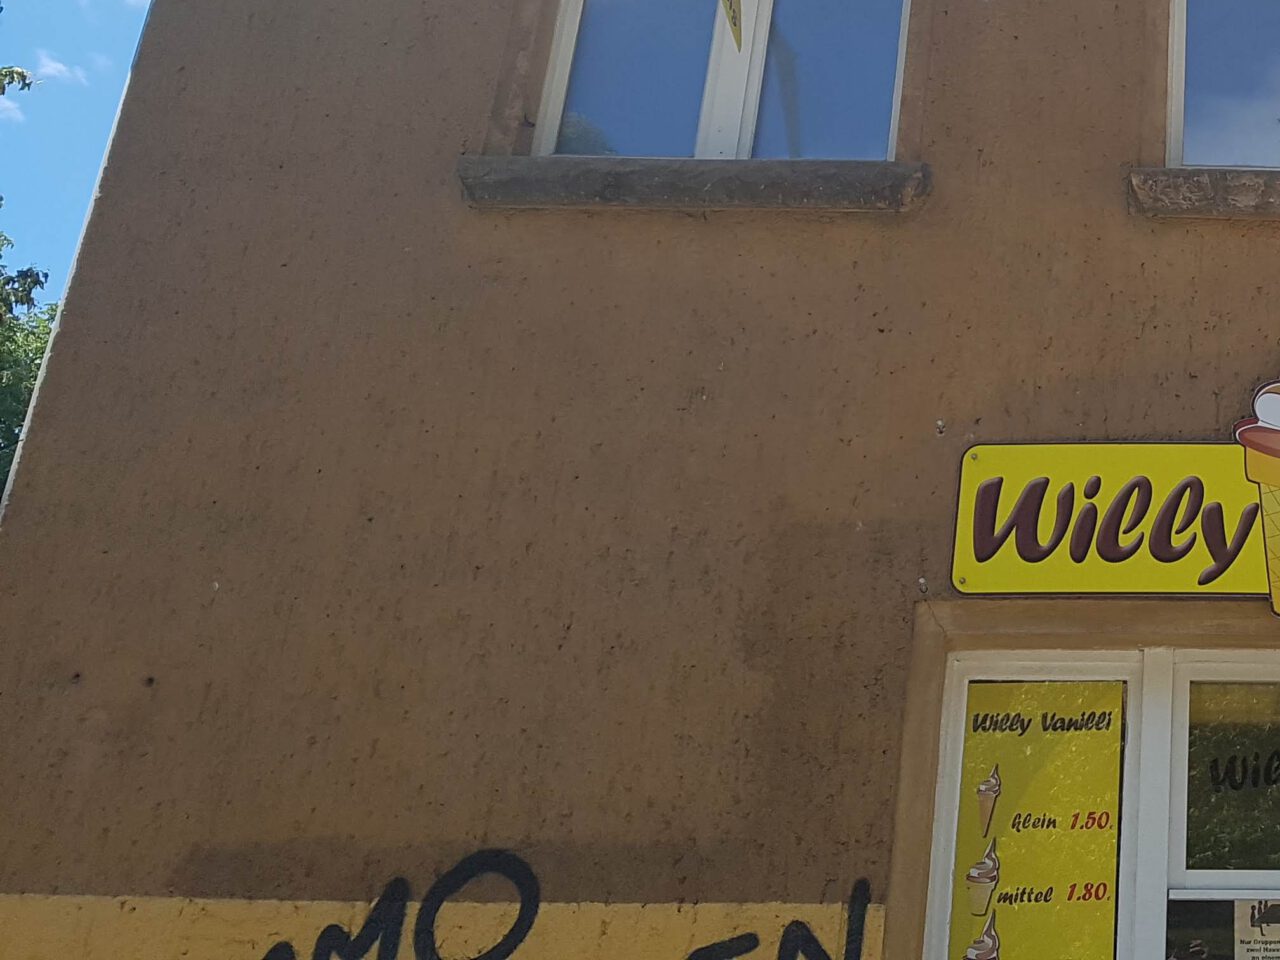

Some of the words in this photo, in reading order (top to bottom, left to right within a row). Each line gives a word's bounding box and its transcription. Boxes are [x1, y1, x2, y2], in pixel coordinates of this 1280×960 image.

[972, 474, 1260, 586] Willy
[972, 712, 1032, 737] Willy
[1041, 711, 1113, 733] Vanilli
[1011, 813, 1057, 833] klein
[997, 887, 1053, 906] mittel
